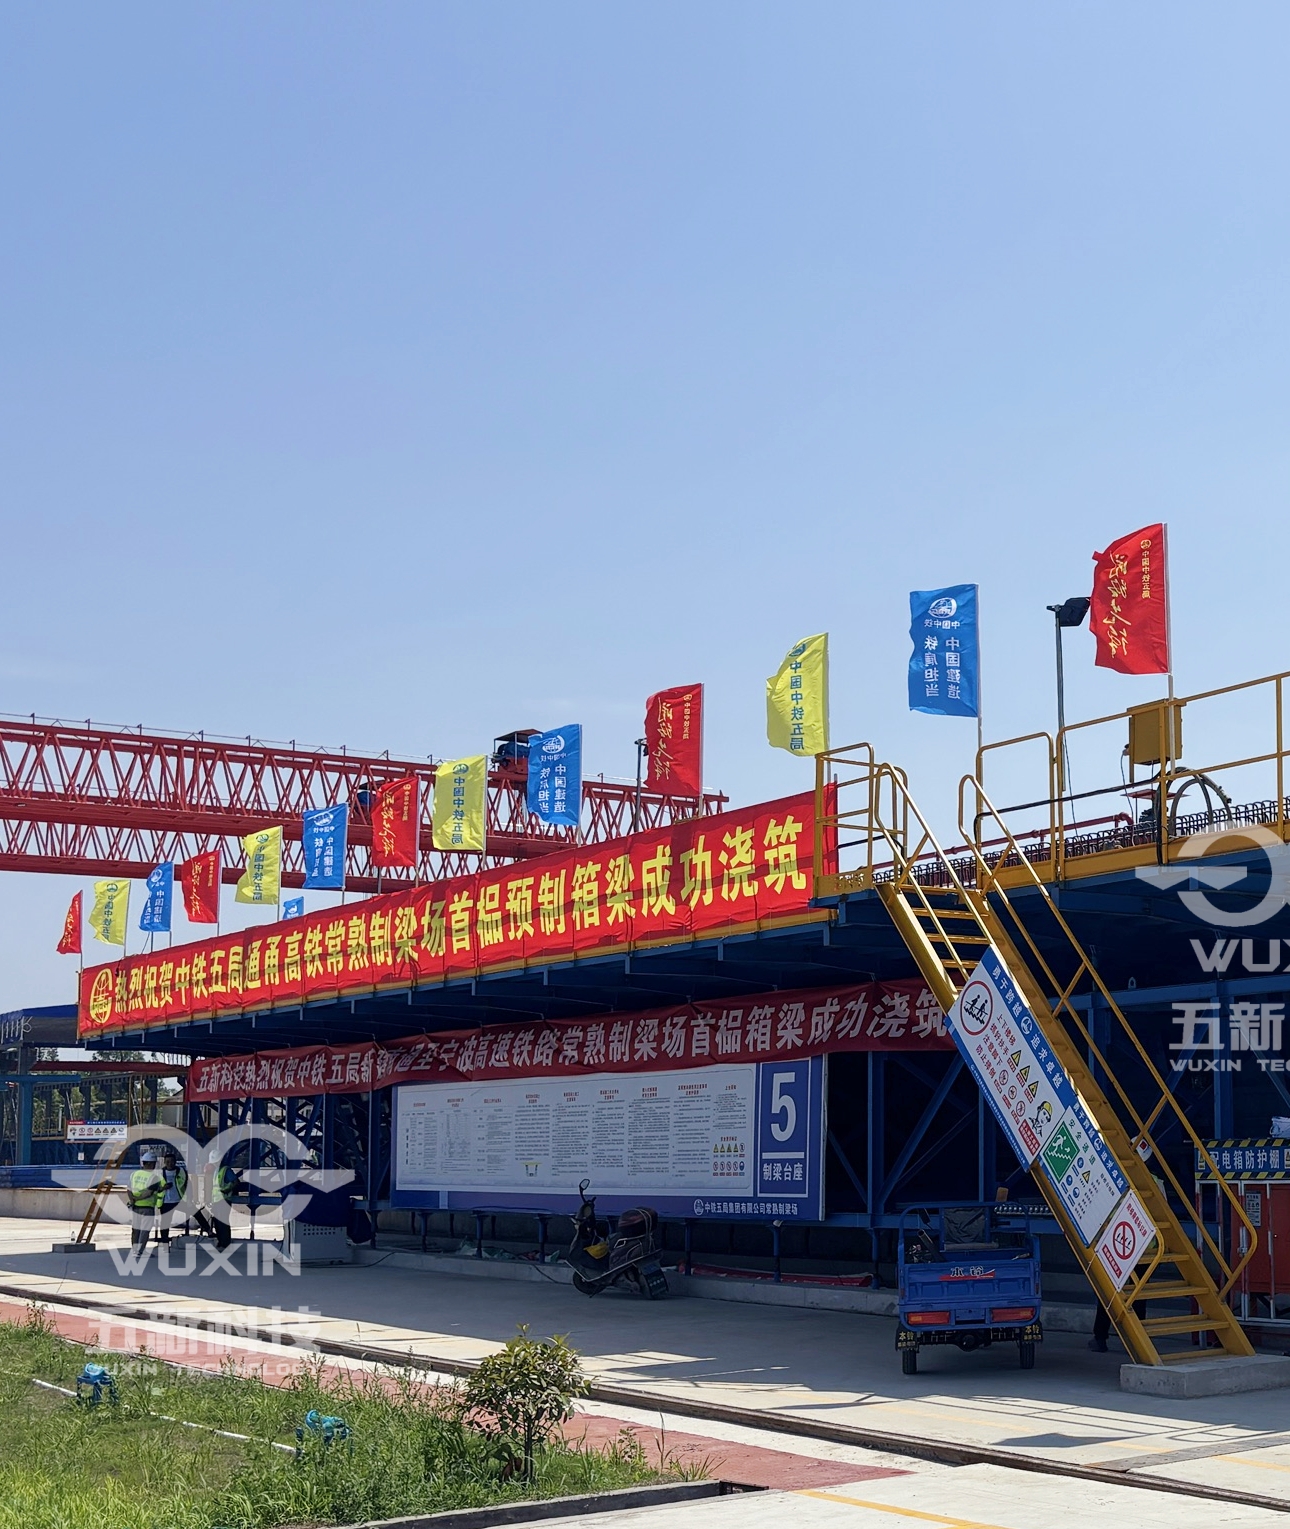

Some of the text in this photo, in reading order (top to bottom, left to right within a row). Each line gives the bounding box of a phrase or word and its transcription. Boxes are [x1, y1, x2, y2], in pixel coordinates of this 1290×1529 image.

[114, 815, 807, 1014] 热烈祝贺中铁五局通甬高铁常熟制梁场首榀预制箱梁成功浇筑
[992, 964, 1063, 1089] 勇于跨越 追求卓越
[770, 1072, 797, 1142] 5
[763, 1163, 803, 1181] 制梁台座
[1210, 1149, 1280, 1170] 配电箱防护棚
[704, 1202, 798, 1216] 中铁五局集团有限公司常熟制梁场
